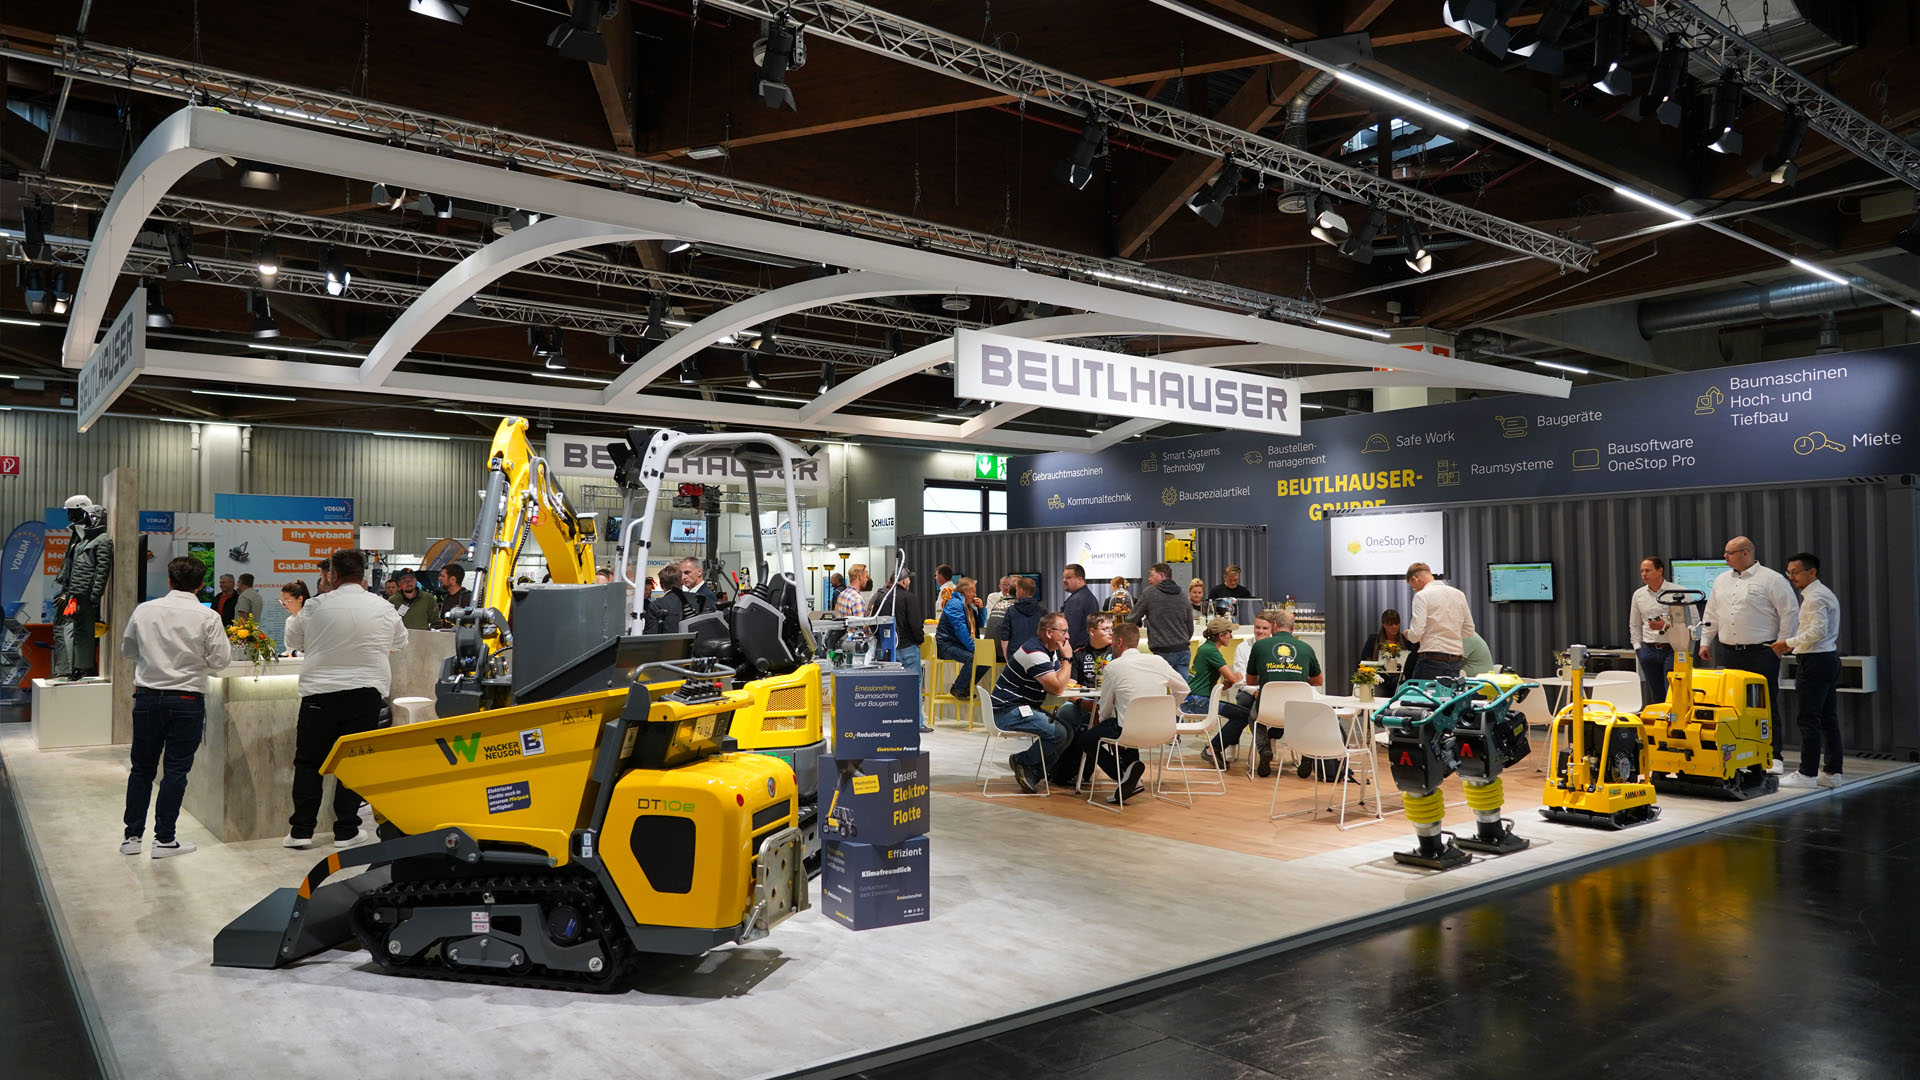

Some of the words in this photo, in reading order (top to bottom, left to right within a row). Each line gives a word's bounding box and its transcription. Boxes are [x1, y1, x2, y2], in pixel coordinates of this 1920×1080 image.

[981, 344, 1288, 422] BEUTLHAUSER
[1730, 366, 1848, 390] Baumaschinen
[1730, 394, 1776, 408] Hoch-
[1782, 388, 1812, 403] und
[1537, 410, 1602, 429] Baugeräte
[1731, 410, 1788, 426] Tiefbau
[1396, 434, 1421, 448] Safe
[1425, 430, 1455, 444] Work
[1608, 437, 1694, 455] Bausoftware
[1852, 431, 1901, 448] Miete
[1162, 450, 1186, 461] Smart
[1188, 447, 1221, 460] Systems
[1267, 443, 1318, 455] Baustellen-
[1162, 460, 1205, 474] Technology
[1268, 454, 1326, 469] management
[1471, 457, 1554, 477] Raumsysteme
[1608, 456, 1668, 473] OneStop
[1672, 454, 1696, 468] Pro
[1032, 466, 1103, 481] Gebrauchtmaschinen
[1277, 469, 1423, 497] BEUTLHAUSER-
[1067, 492, 1131, 507] Kommunaltechnik
[1179, 486, 1250, 501] Bauspezialartikel
[1366, 536, 1405, 547] OneStop
[1408, 535, 1425, 544] Pro
[11, 540, 31, 571] VDBUM
[483, 741, 520, 753] WACKER
[485, 749, 521, 760] NEUSON
[893, 770, 917, 783] Unsere
[893, 784, 928, 803] Elektro-
[638, 798, 696, 812] DT10e
[893, 806, 921, 826] Flotte
[888, 848, 922, 859] Effizient
[861, 866, 912, 878] Klimafreundlich
